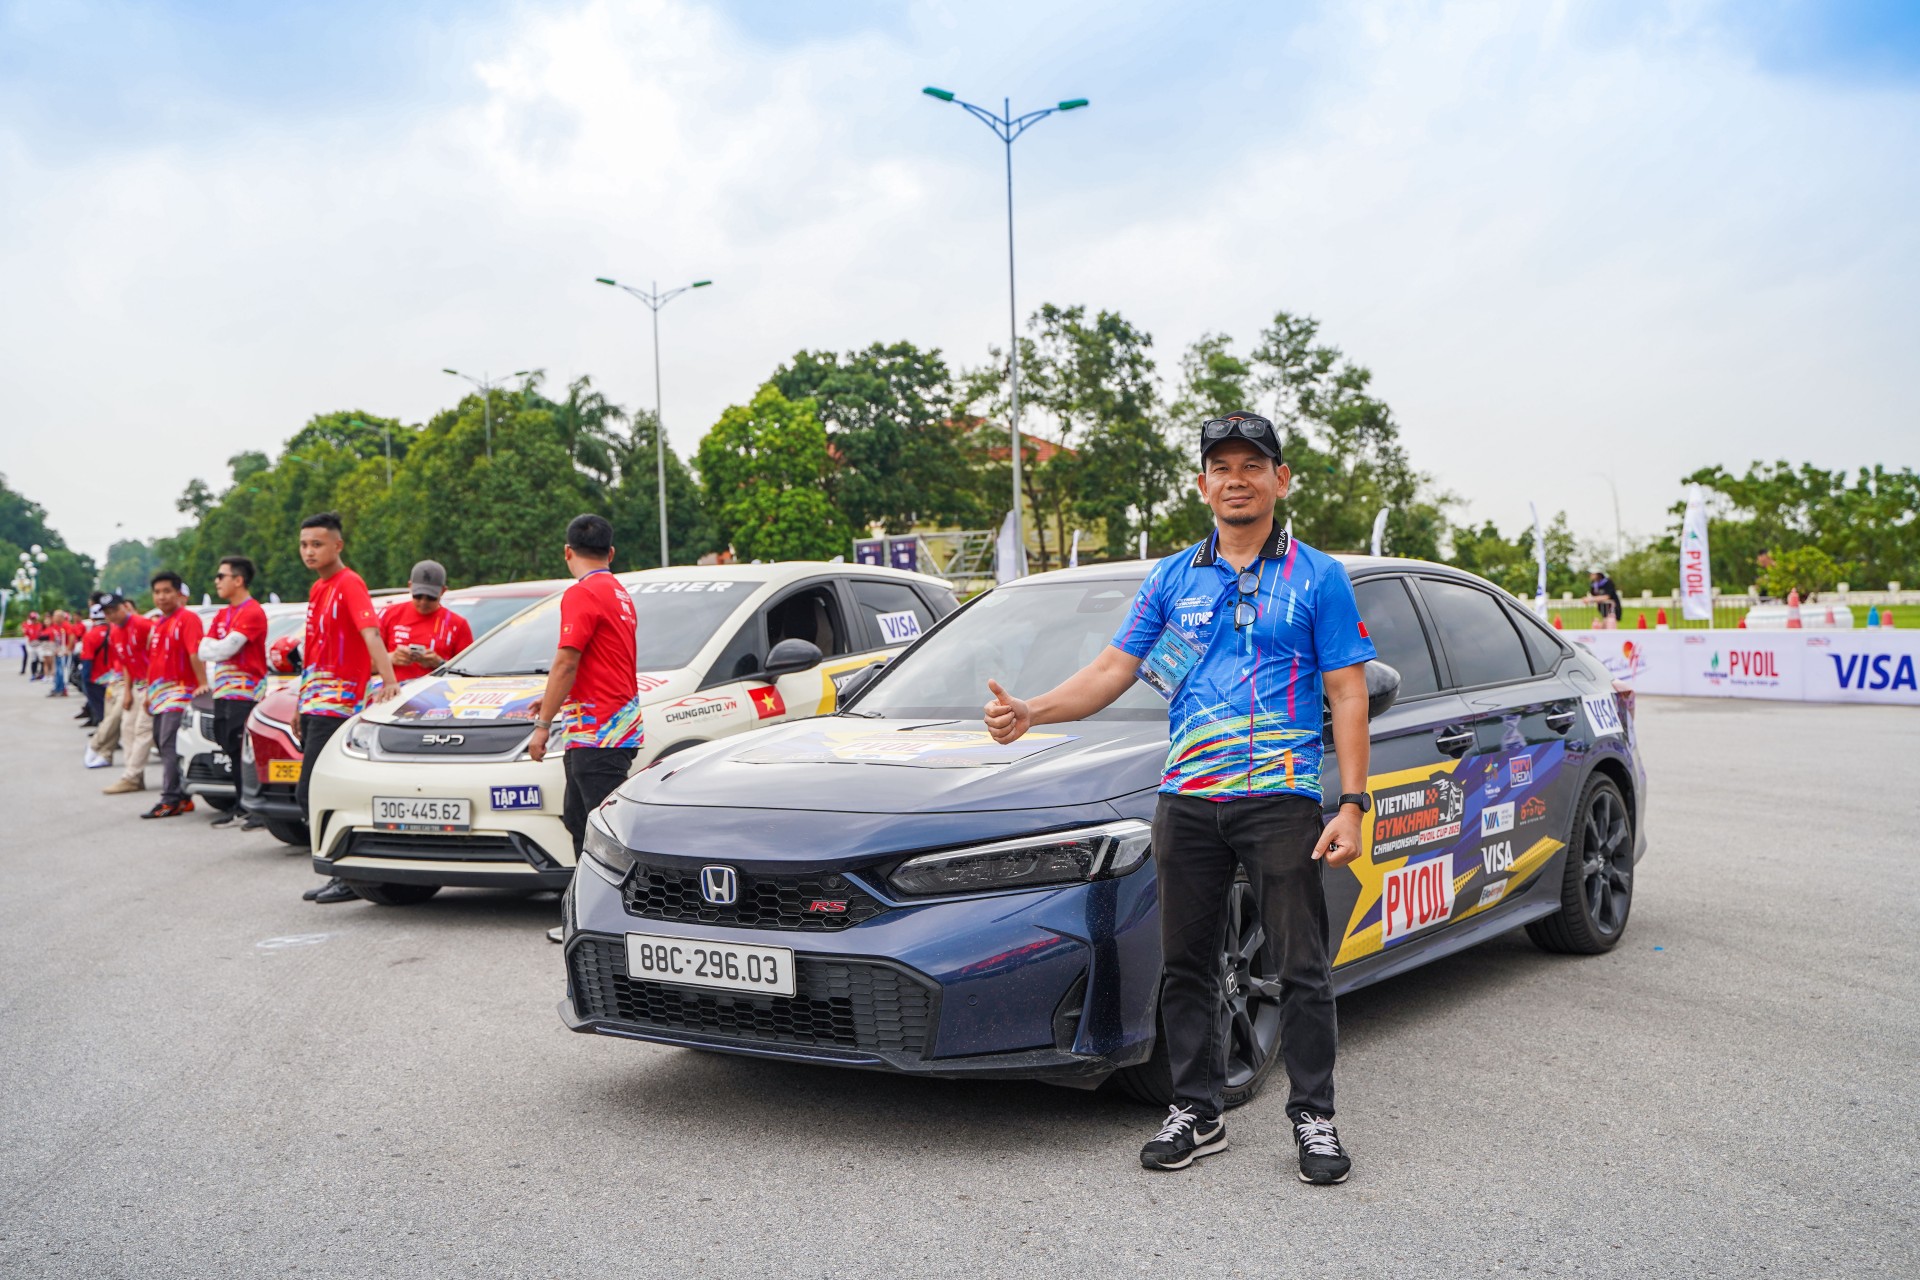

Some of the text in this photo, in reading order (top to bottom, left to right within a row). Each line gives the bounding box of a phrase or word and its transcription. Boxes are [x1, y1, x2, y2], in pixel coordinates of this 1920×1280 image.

[1686, 550, 1704, 597] PVOIL
[882, 615, 919, 638] VISA
[1729, 651, 1779, 677] PVOIL
[1827, 654, 1917, 691] VISA
[454, 692, 510, 705] PVOIL
[665, 701, 737, 723] CHUNGAUTO.VN
[1585, 699, 1621, 729] VISA
[422, 734, 465, 746] BYD
[493, 787, 539, 809] TẬP LÁI
[1376, 790, 1425, 817] VIETNAM
[1375, 807, 1439, 841] GYMKHANA
[1373, 824, 1460, 856] CHAMPIONSHIP PVOIL CUP 2025
[1481, 840, 1515, 875] VISA
[809, 900, 848, 913] RS
[1386, 861, 1450, 937] PVOIL
[641, 943, 778, 985] 88C-296.03
